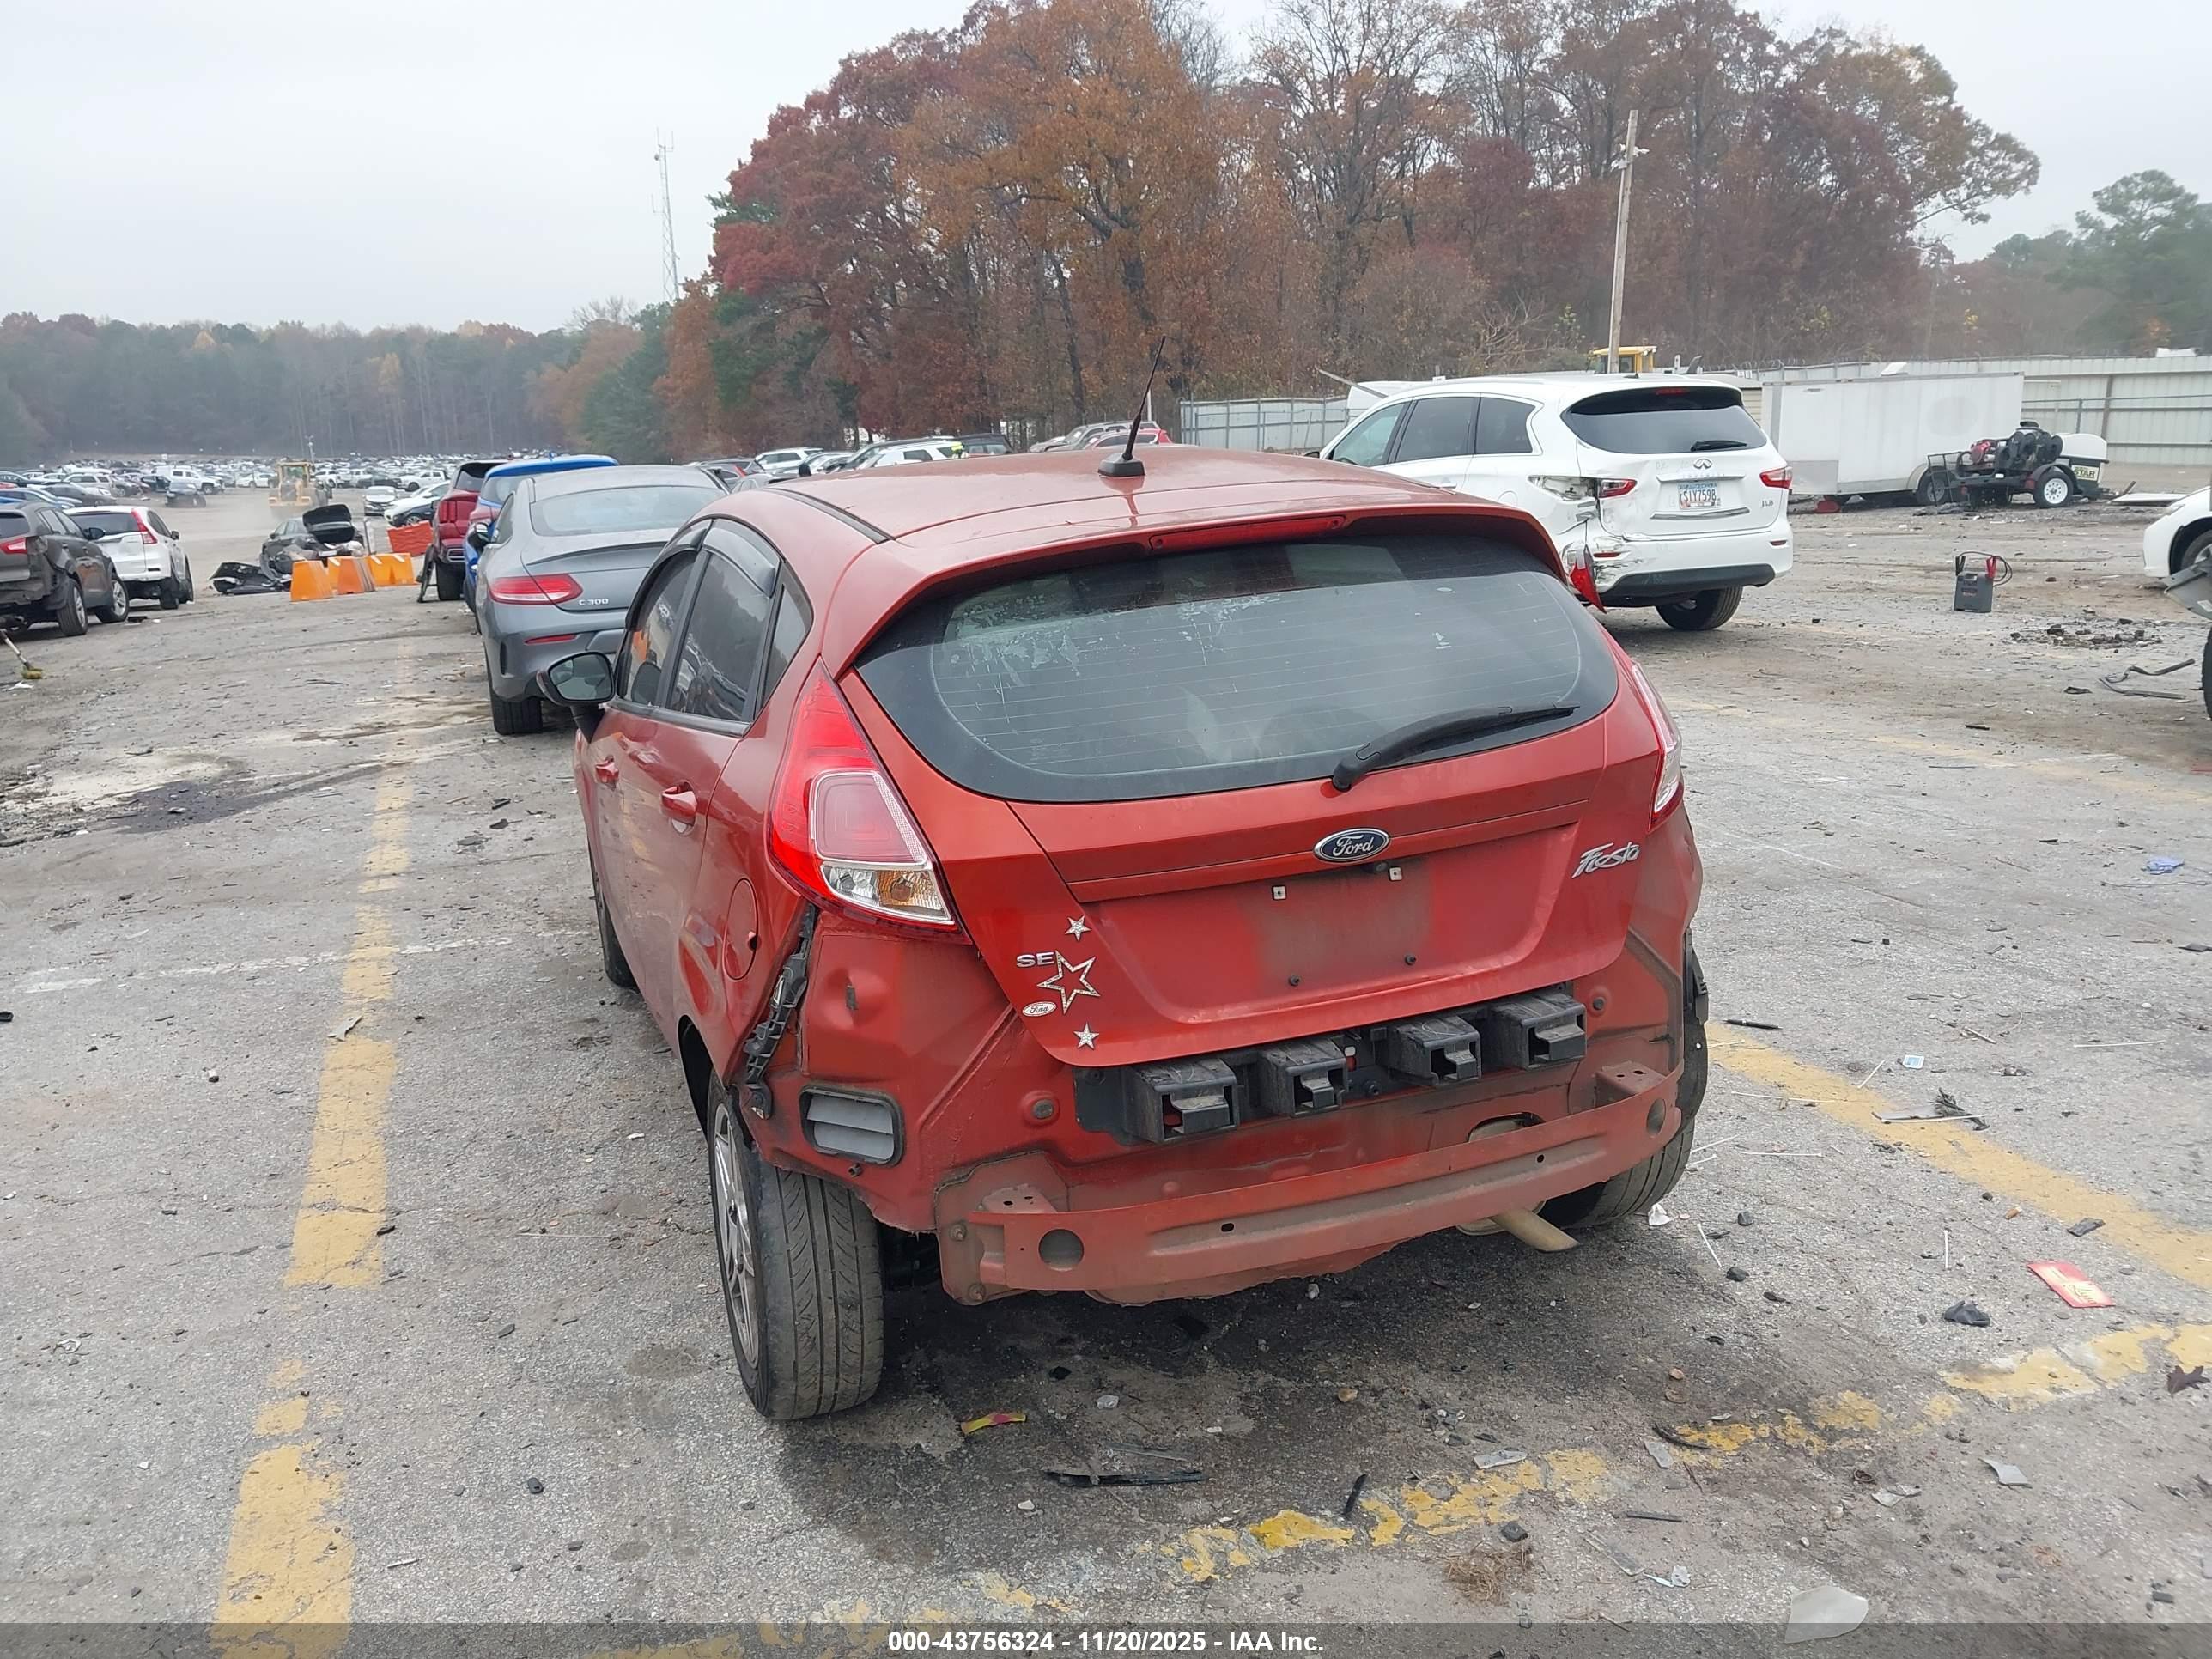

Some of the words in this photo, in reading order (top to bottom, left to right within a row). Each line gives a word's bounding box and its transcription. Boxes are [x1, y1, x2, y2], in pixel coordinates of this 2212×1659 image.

[1333, 835, 1375, 857] Ford
[1571, 842, 1640, 878] Fiesta
[1016, 951, 1055, 968] SE
[1030, 1004, 1049, 1014] Ford
